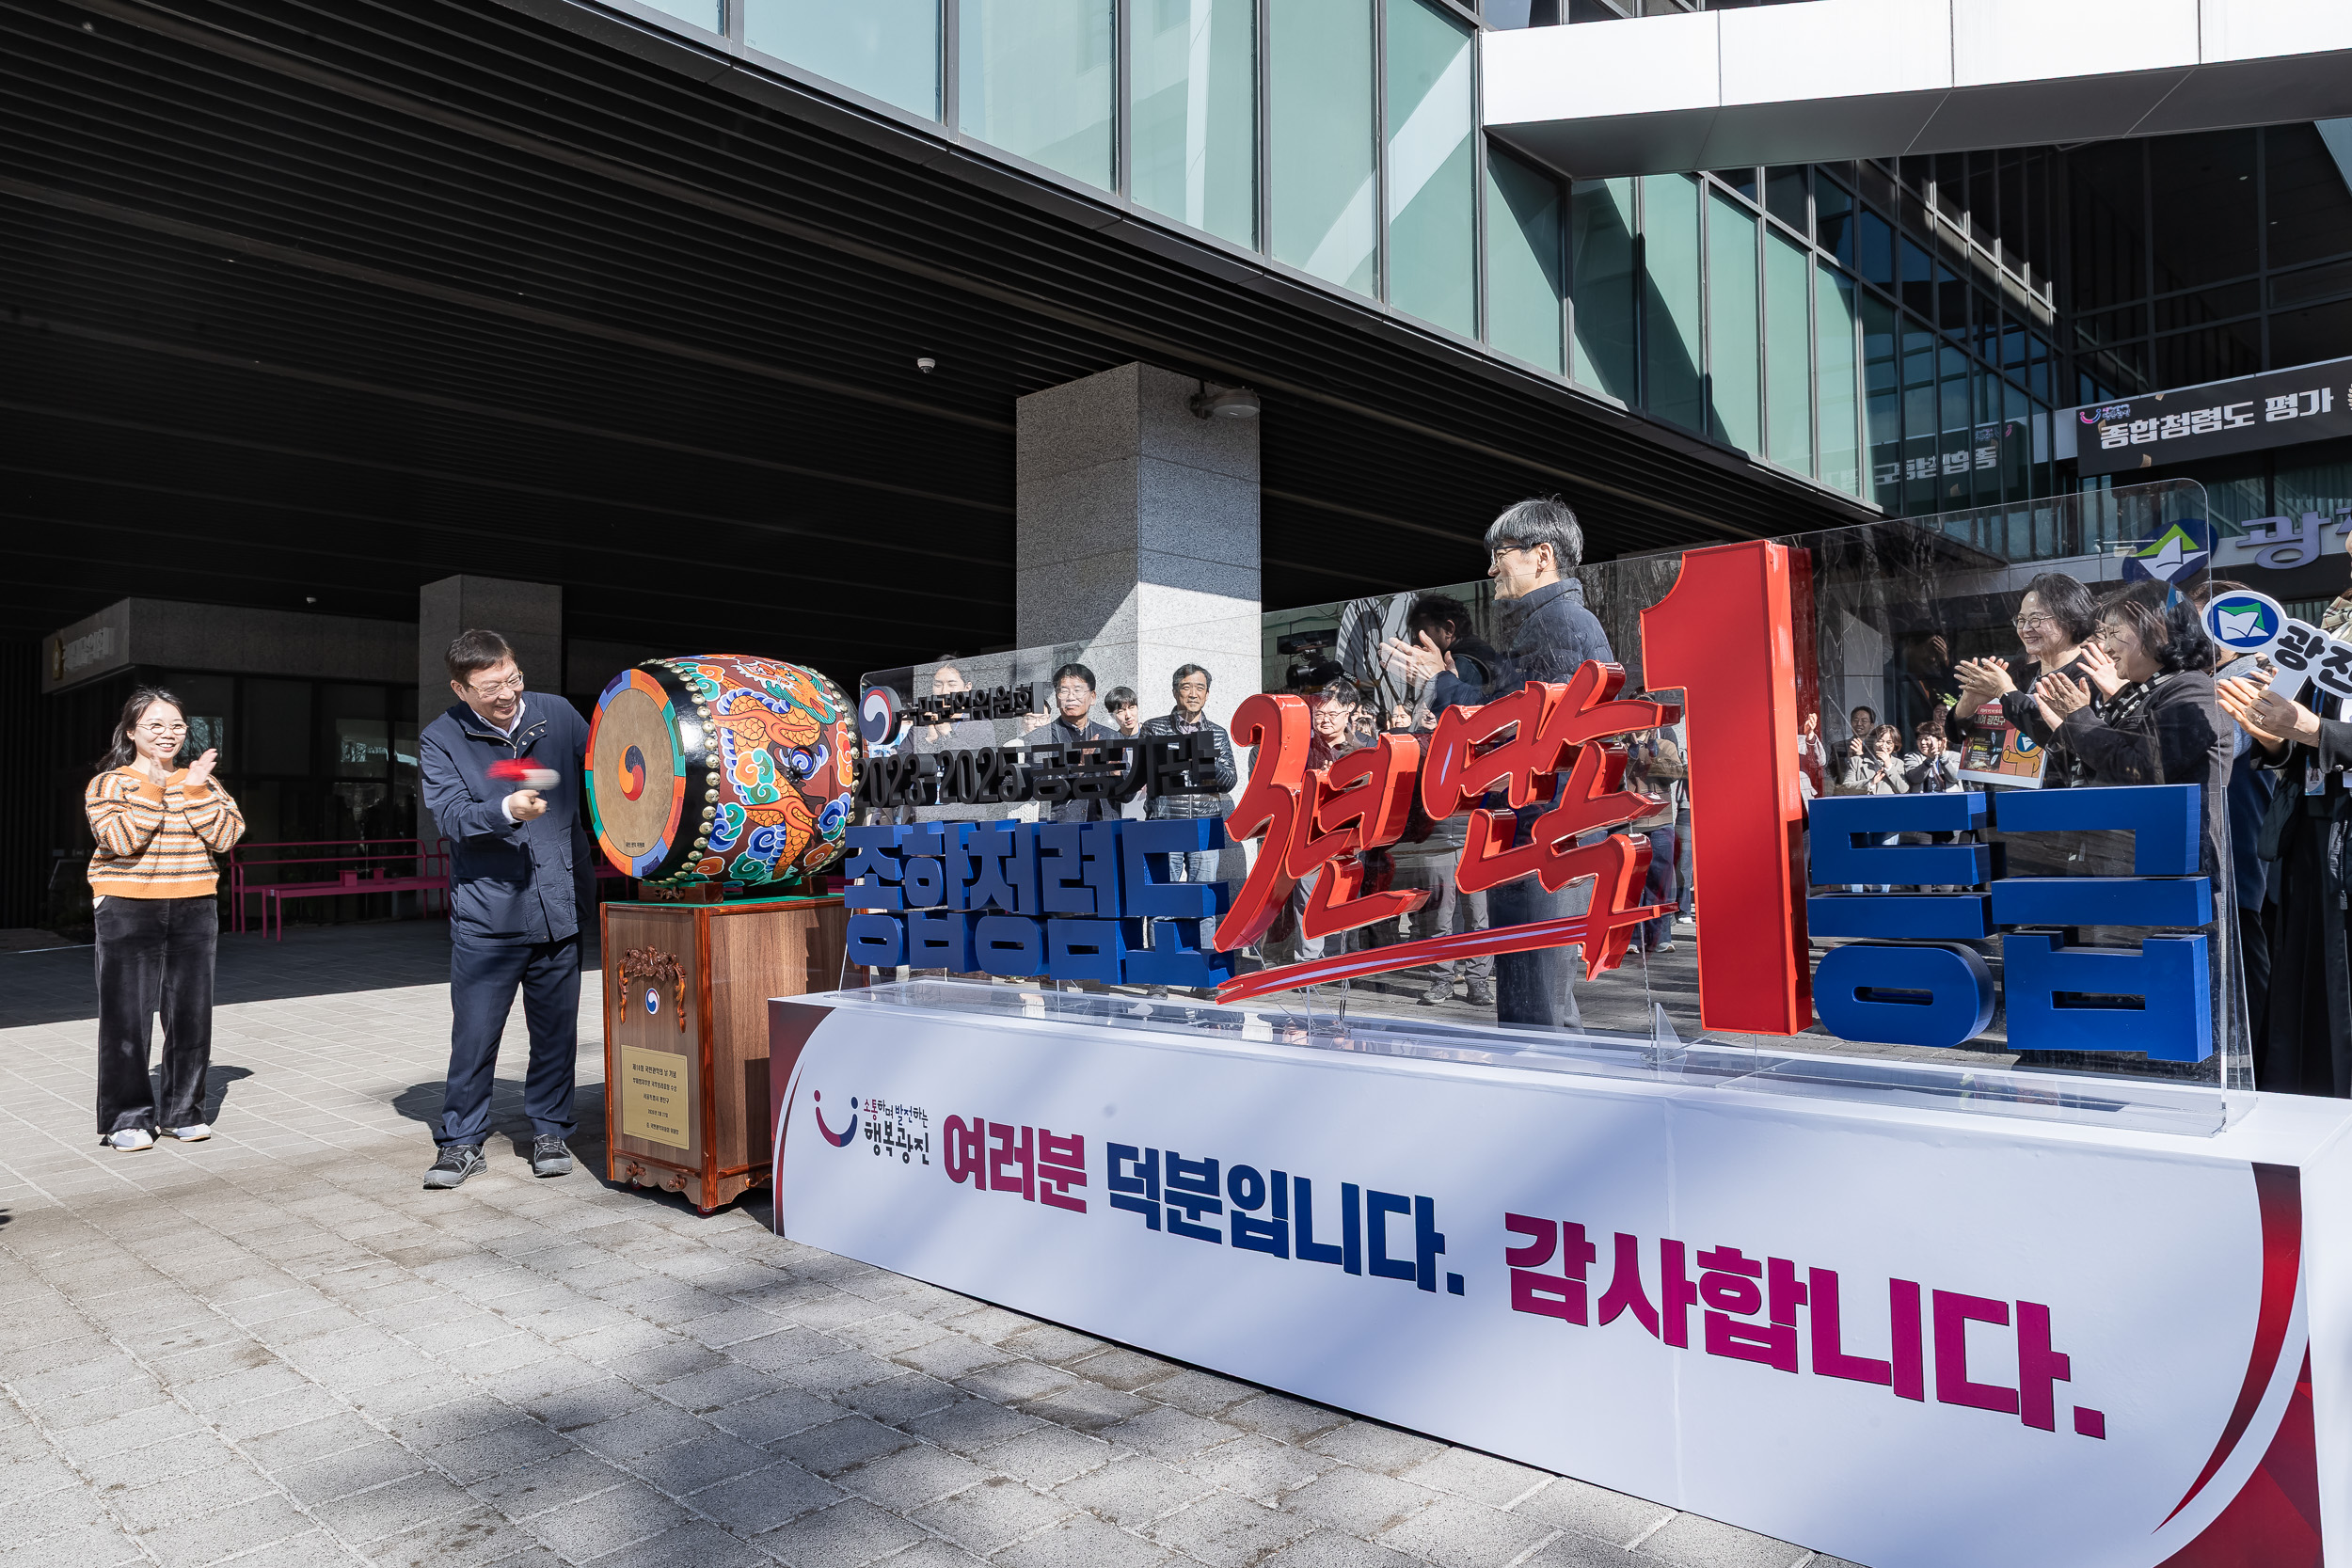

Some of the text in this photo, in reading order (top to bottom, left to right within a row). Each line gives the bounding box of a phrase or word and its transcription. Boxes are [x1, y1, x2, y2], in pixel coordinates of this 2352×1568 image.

[2100, 387, 2334, 450] 종합청렴도 평가
[1987, 715, 2006, 726] 광진구
[1031, 731, 1221, 804] 공공기관
[845, 817, 1234, 988] 종합청렴도
[863, 1099, 929, 1129] 소통하며 발전하는
[864, 1121, 930, 1165] 행복광진
[943, 1114, 2106, 1440] 여러분 덕분입니다. 감사합니다.
